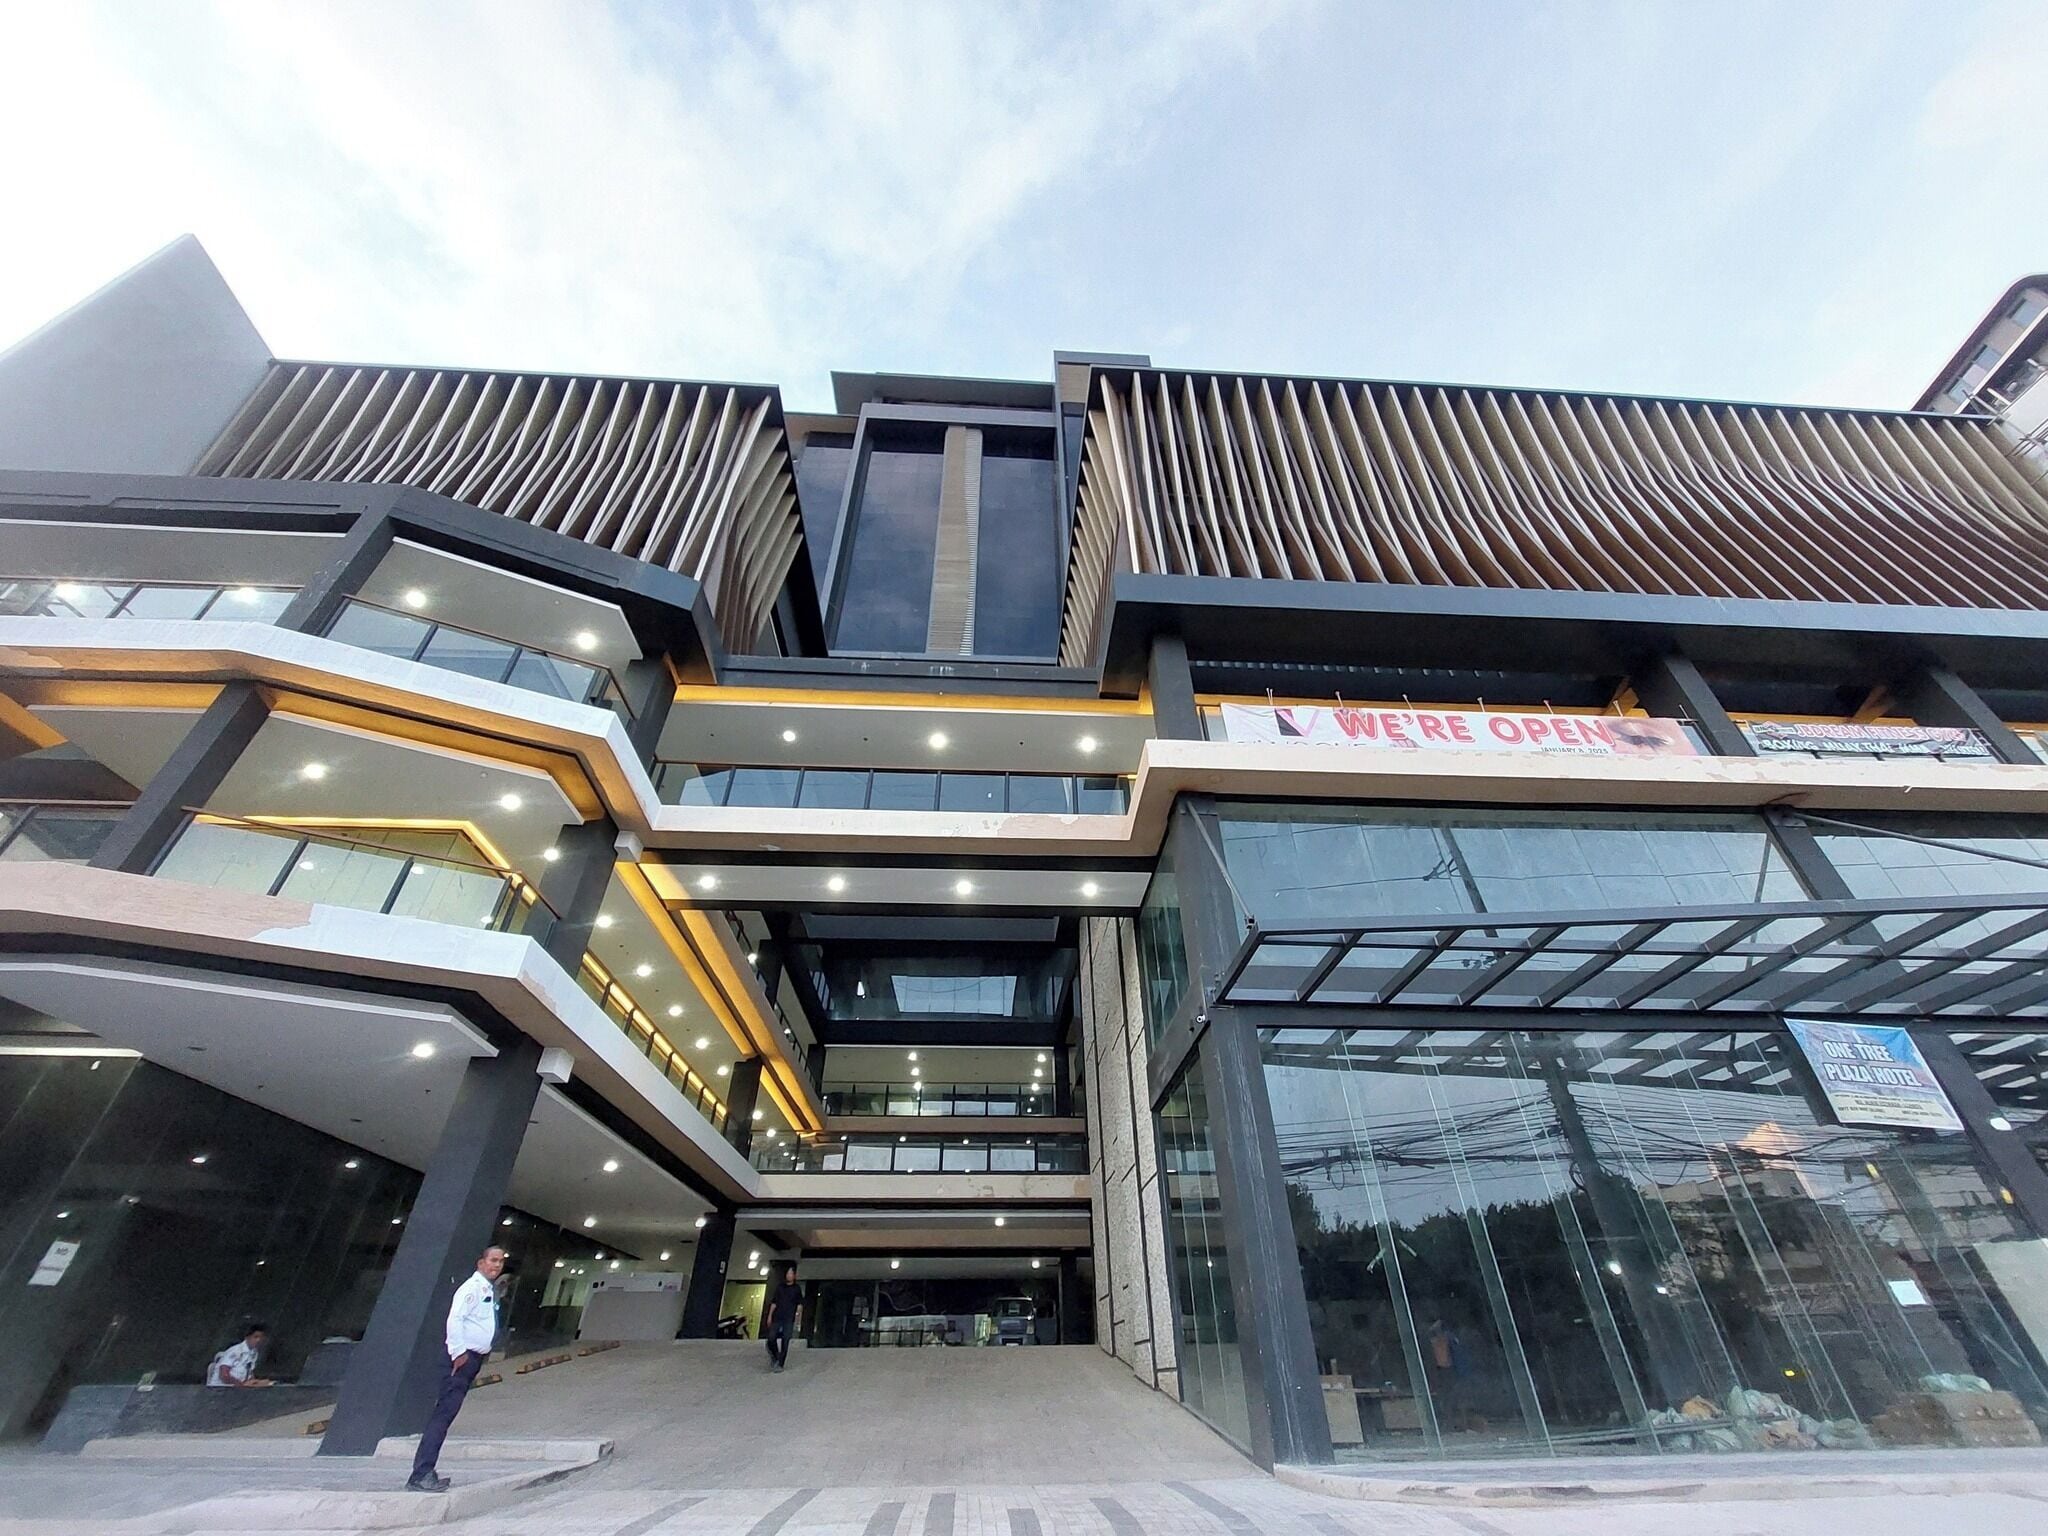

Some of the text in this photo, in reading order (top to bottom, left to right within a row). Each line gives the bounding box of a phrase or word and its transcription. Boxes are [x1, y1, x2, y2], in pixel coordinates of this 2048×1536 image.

[1333, 711, 1616, 747] WE'RE OPEN
[1822, 1041, 1894, 1062] ONE TREE
[1822, 1062, 1923, 1087] PLAZA HOTEL
